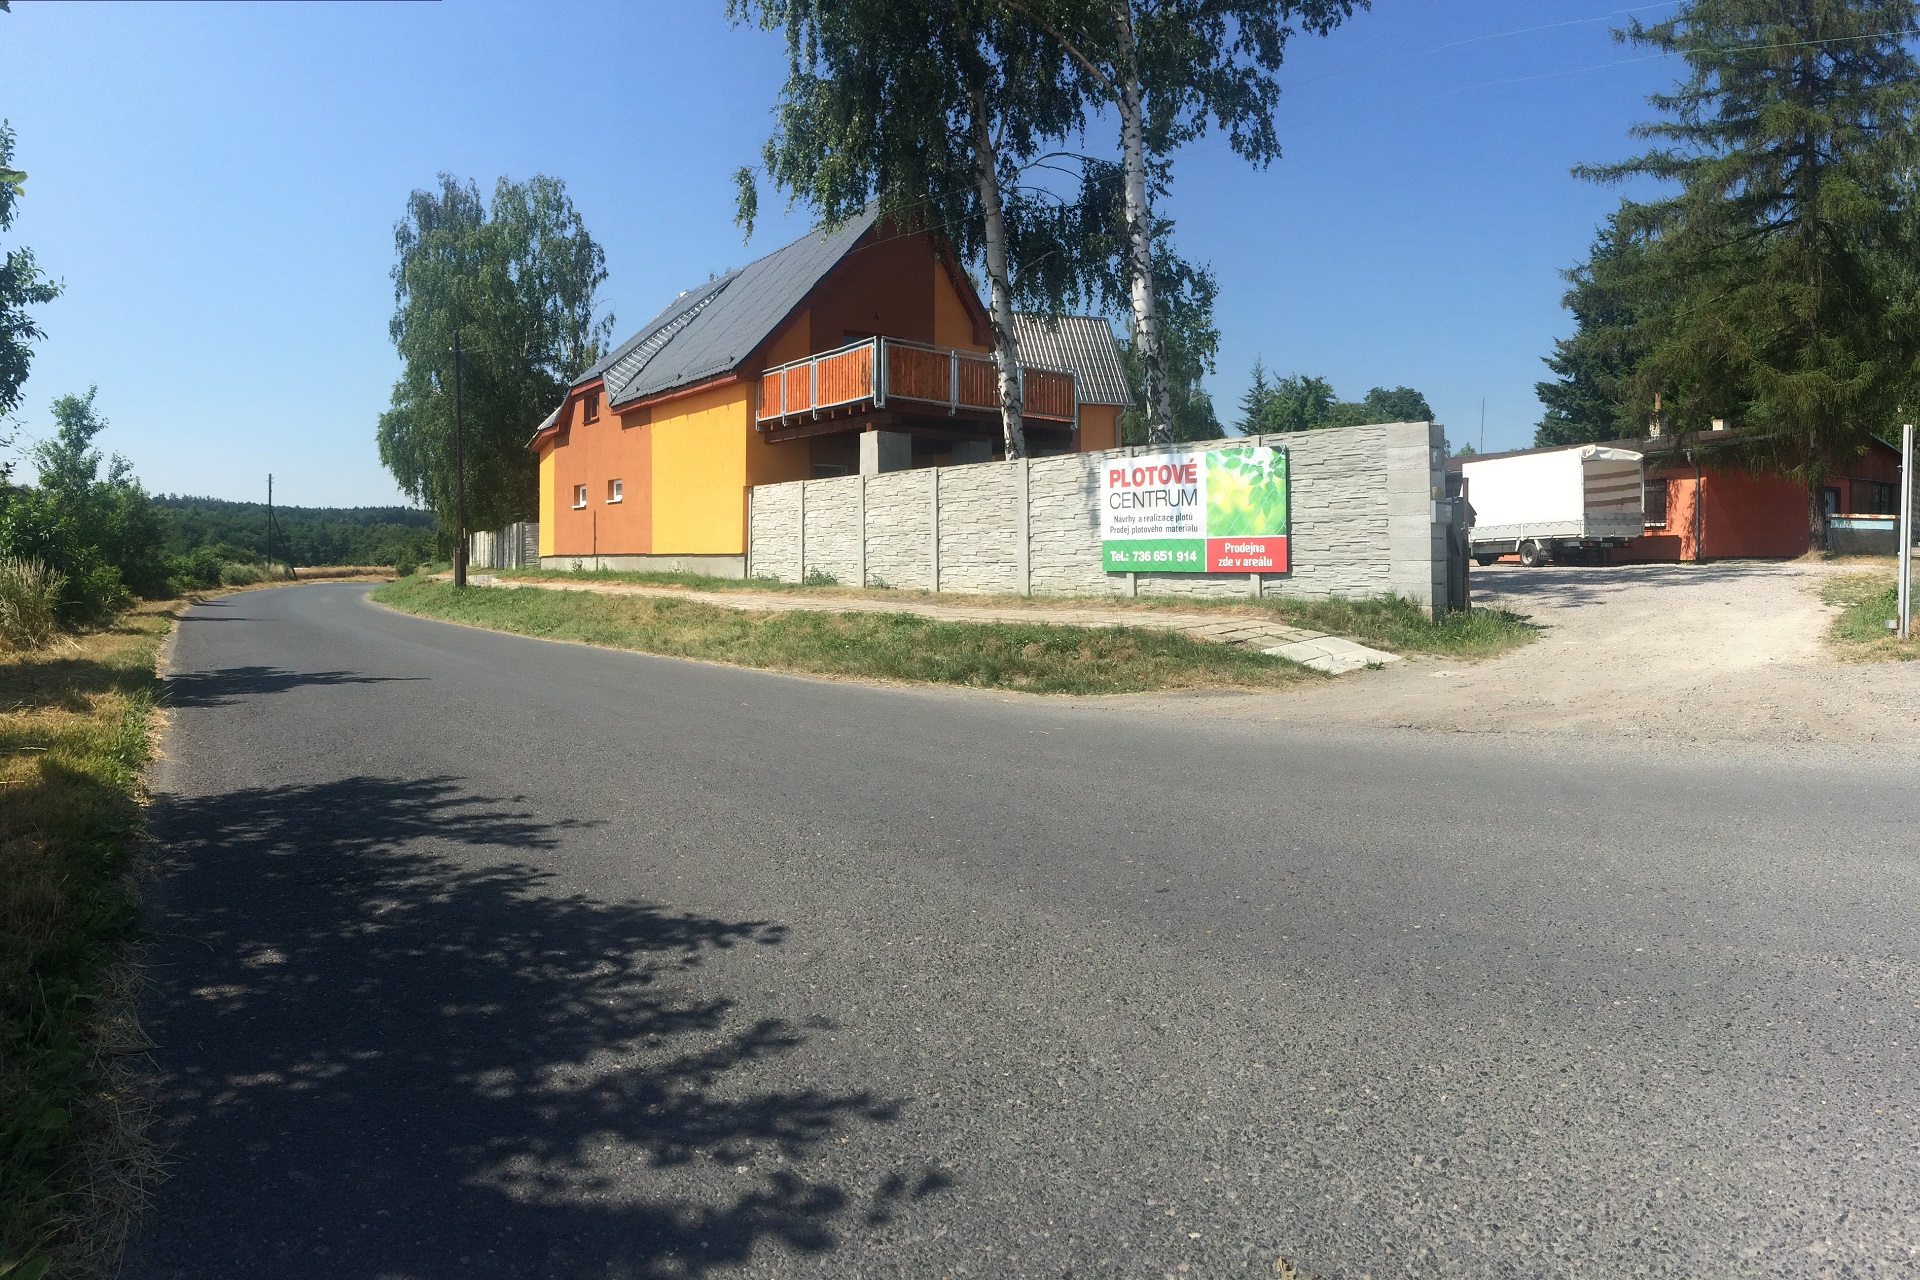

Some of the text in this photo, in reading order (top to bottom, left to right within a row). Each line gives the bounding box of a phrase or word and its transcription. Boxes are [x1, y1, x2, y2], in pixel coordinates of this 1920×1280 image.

[1109, 458, 1198, 488] PLOTOVÉ
[1109, 488, 1198, 509] CENTRUM
[1113, 514, 1136, 524] Návrhy
[1143, 513, 1174, 522] realizace
[1109, 523, 1198, 535] Prodej plotového materiálu
[1224, 542, 1265, 555] Prodejna
[1109, 550, 1198, 562] Tel.: 736 651 914
[1218, 555, 1273, 567] zde v areálu
